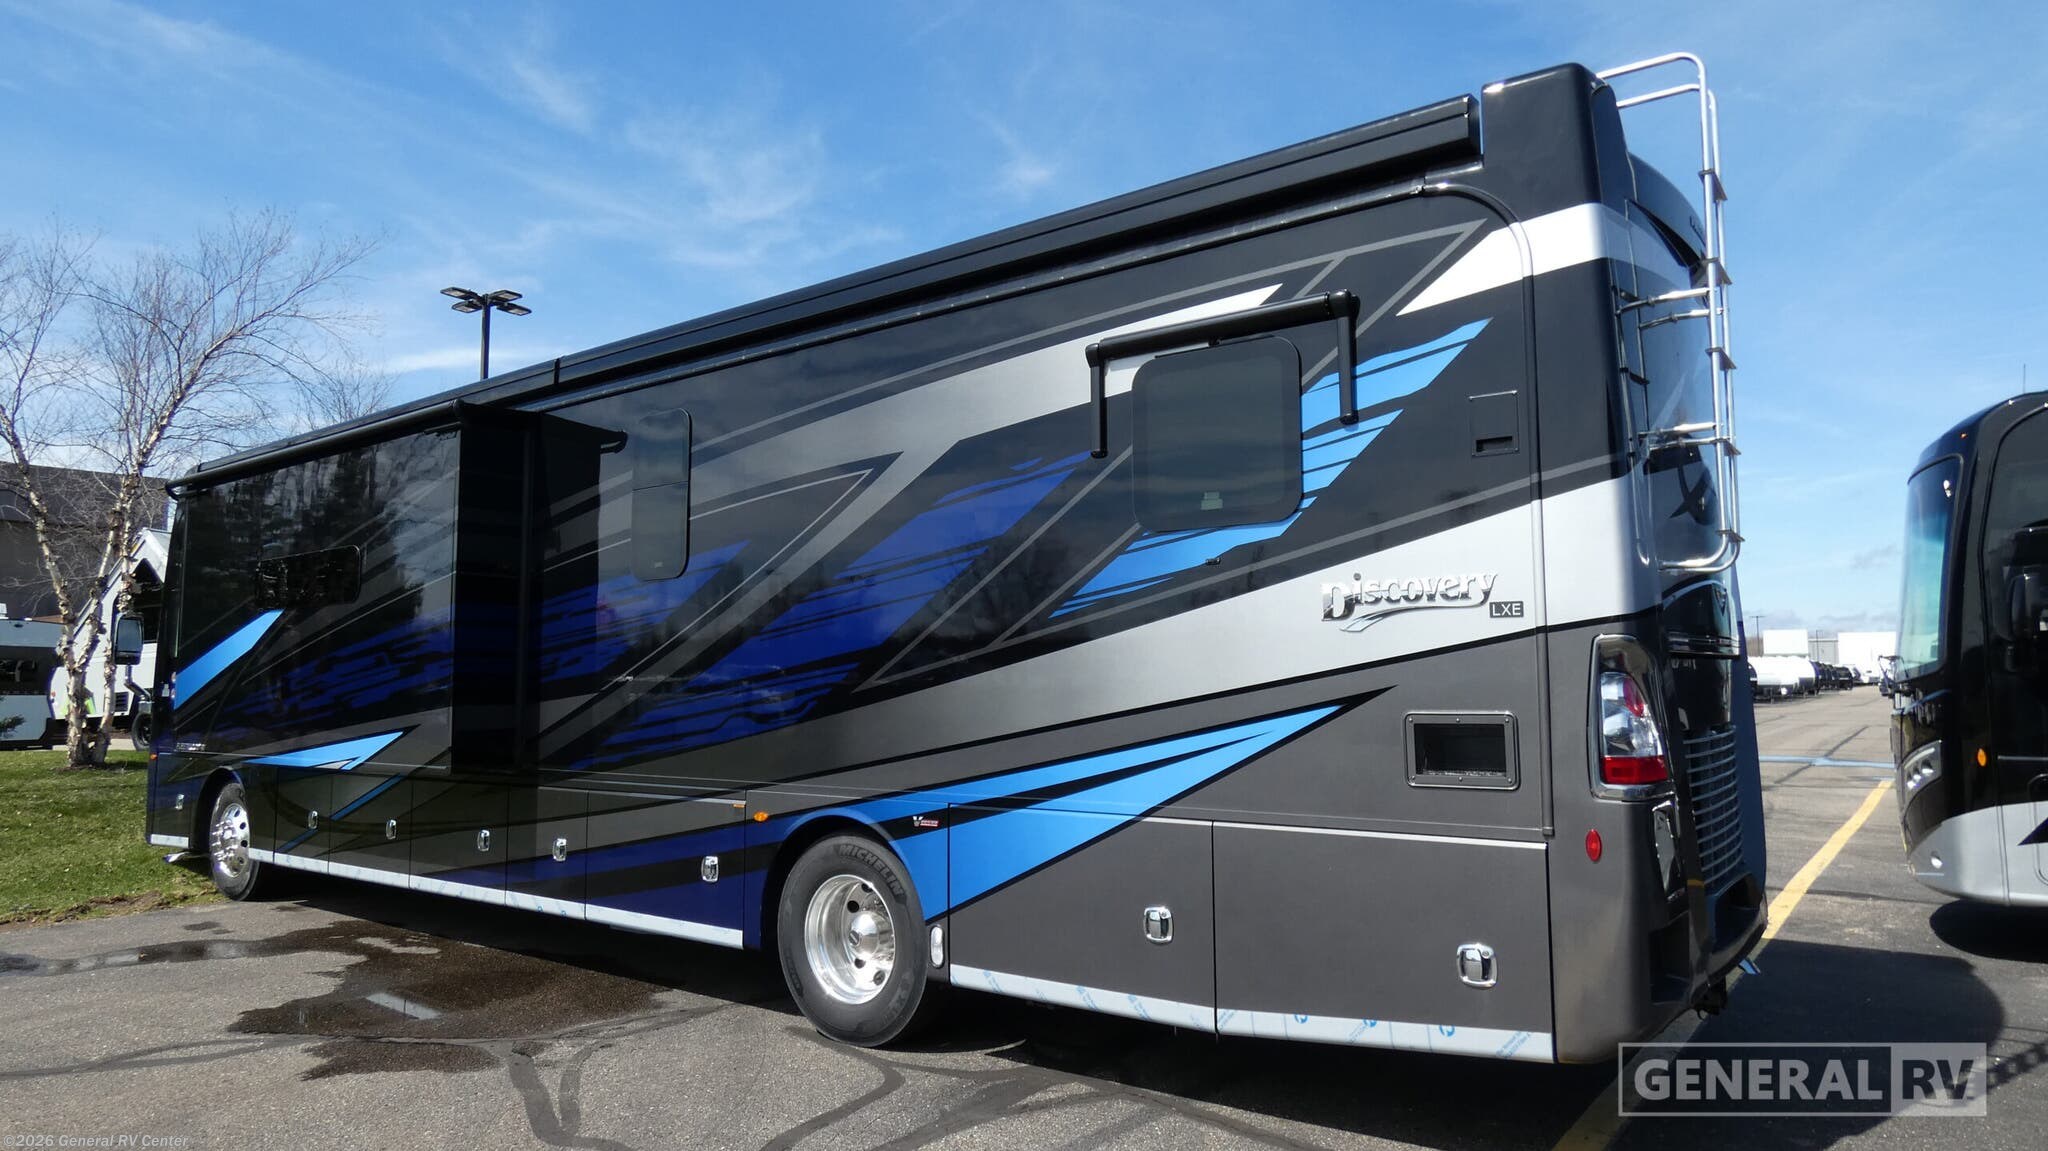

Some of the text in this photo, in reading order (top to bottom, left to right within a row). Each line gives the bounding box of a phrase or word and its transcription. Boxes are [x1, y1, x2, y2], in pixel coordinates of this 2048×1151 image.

[1321, 572, 1522, 630] Discovery LXE
[838, 844, 904, 896] MICHELIN
